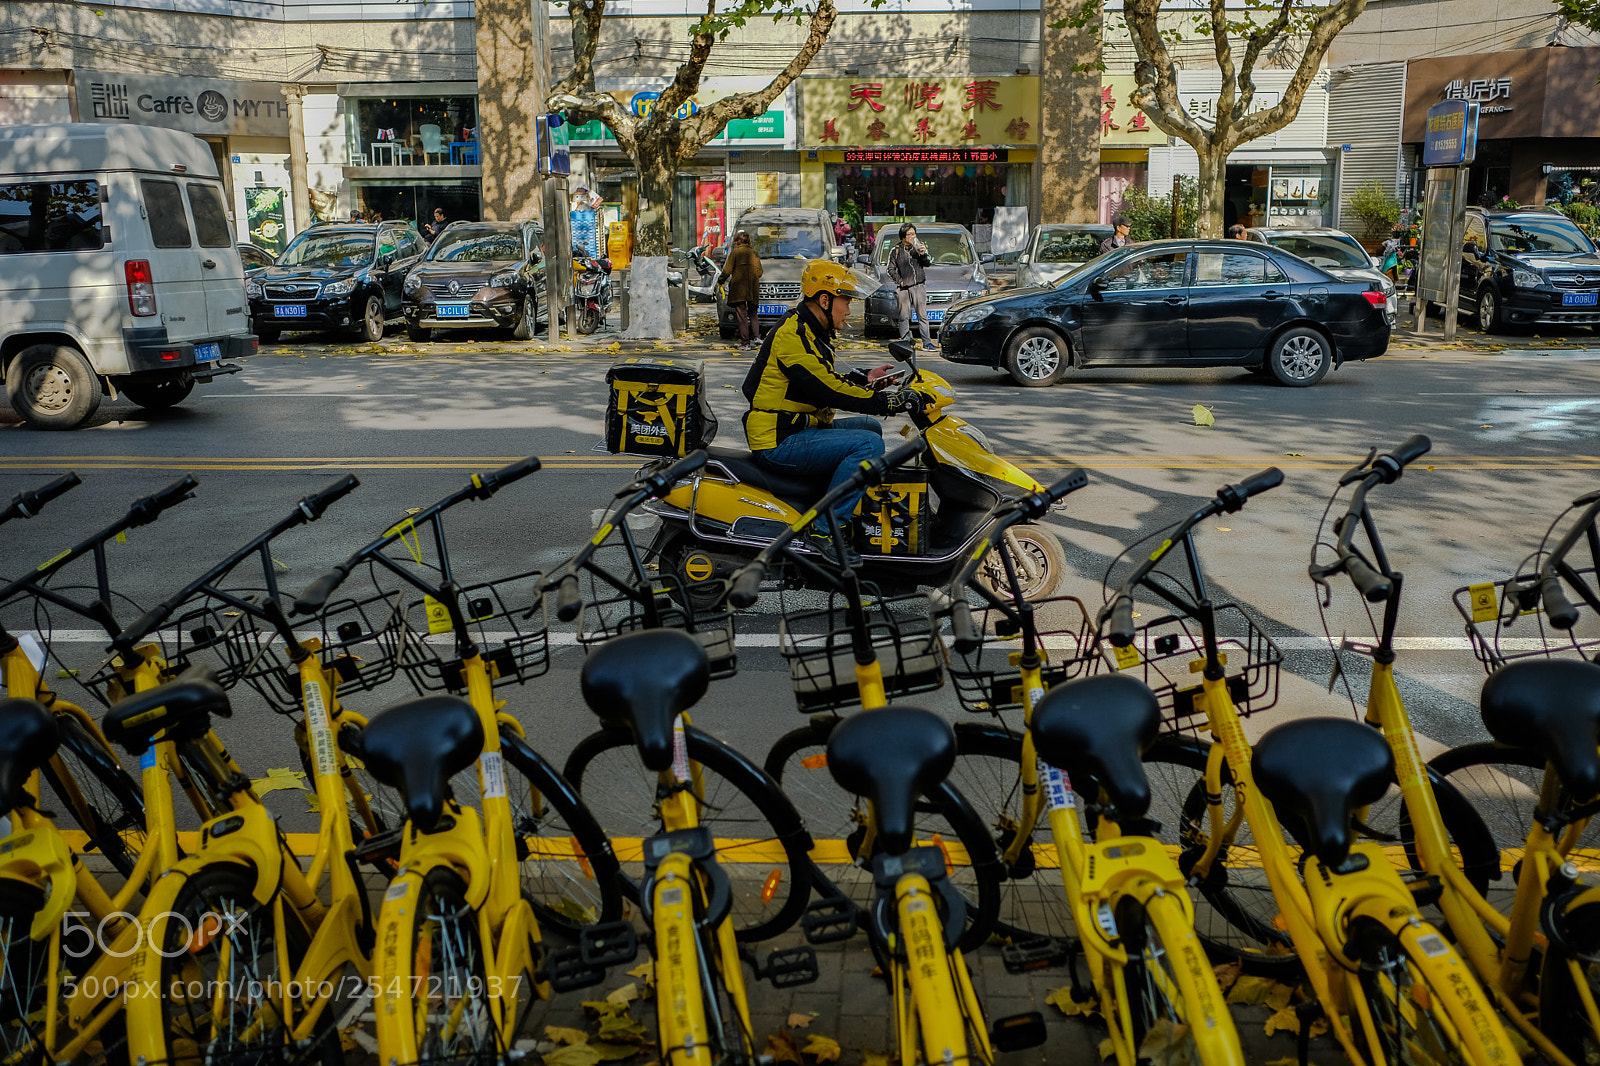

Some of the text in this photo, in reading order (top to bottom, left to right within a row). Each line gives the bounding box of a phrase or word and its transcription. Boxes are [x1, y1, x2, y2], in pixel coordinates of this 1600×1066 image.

[136, 94, 289, 119] Caffè MYTH
[847, 79, 1003, 114] 天悦莱
